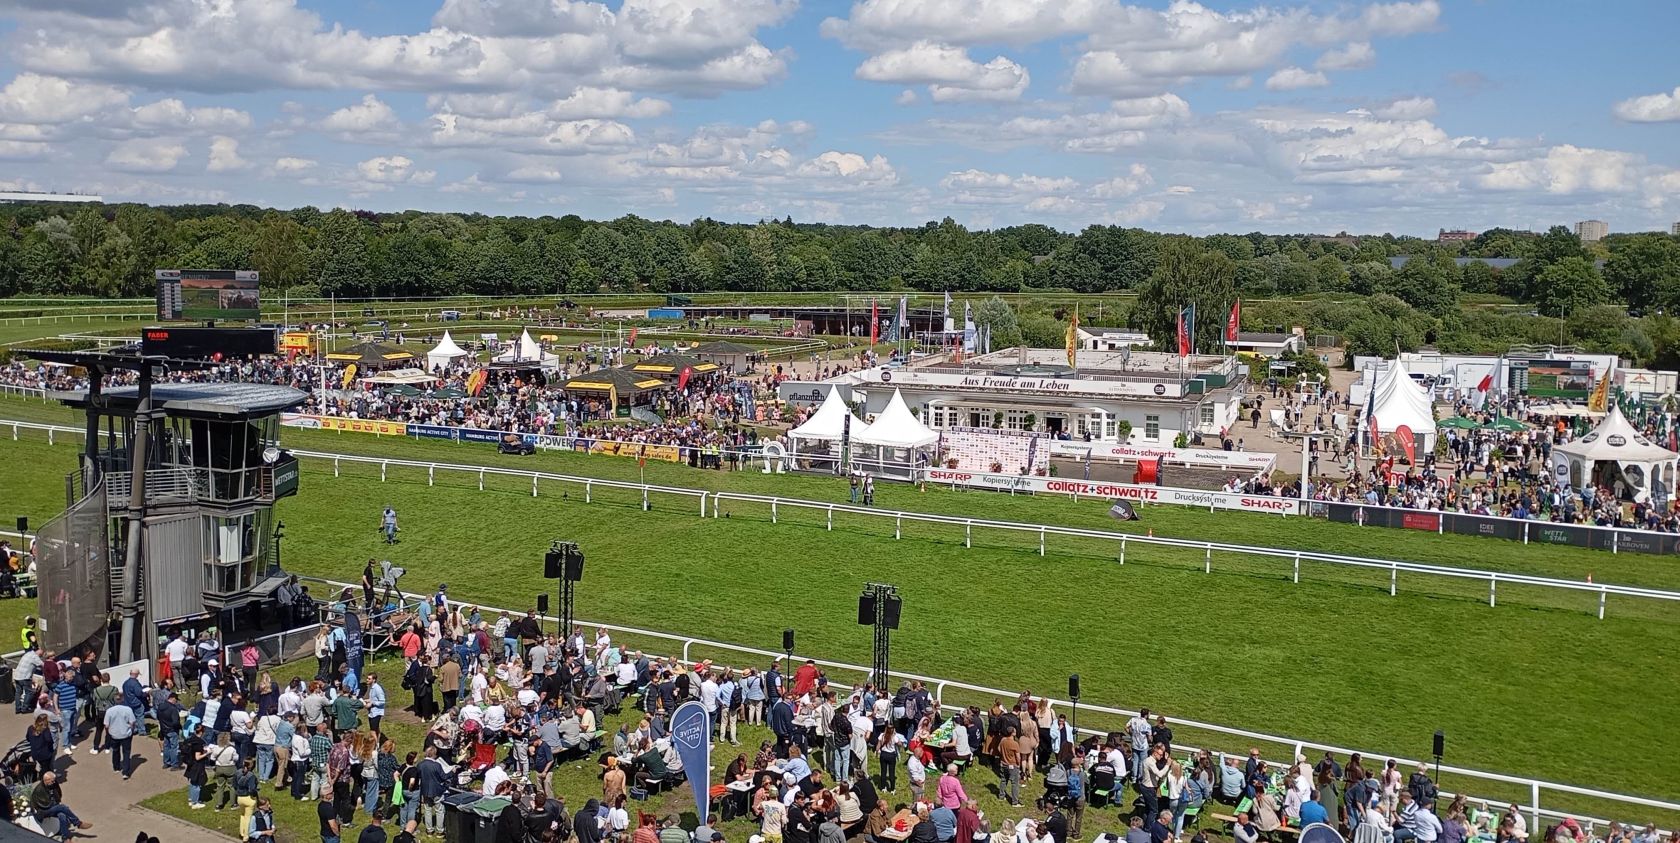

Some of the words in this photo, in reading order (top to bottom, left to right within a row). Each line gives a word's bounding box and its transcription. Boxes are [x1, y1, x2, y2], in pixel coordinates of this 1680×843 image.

[960, 376, 979, 386] Aus
[982, 377, 1017, 388] Freude
[1020, 381, 1036, 389] am
[1038, 379, 1070, 390] Leben
[929, 470, 972, 481] SHARP
[982, 475, 1031, 486] Kopiersytme
